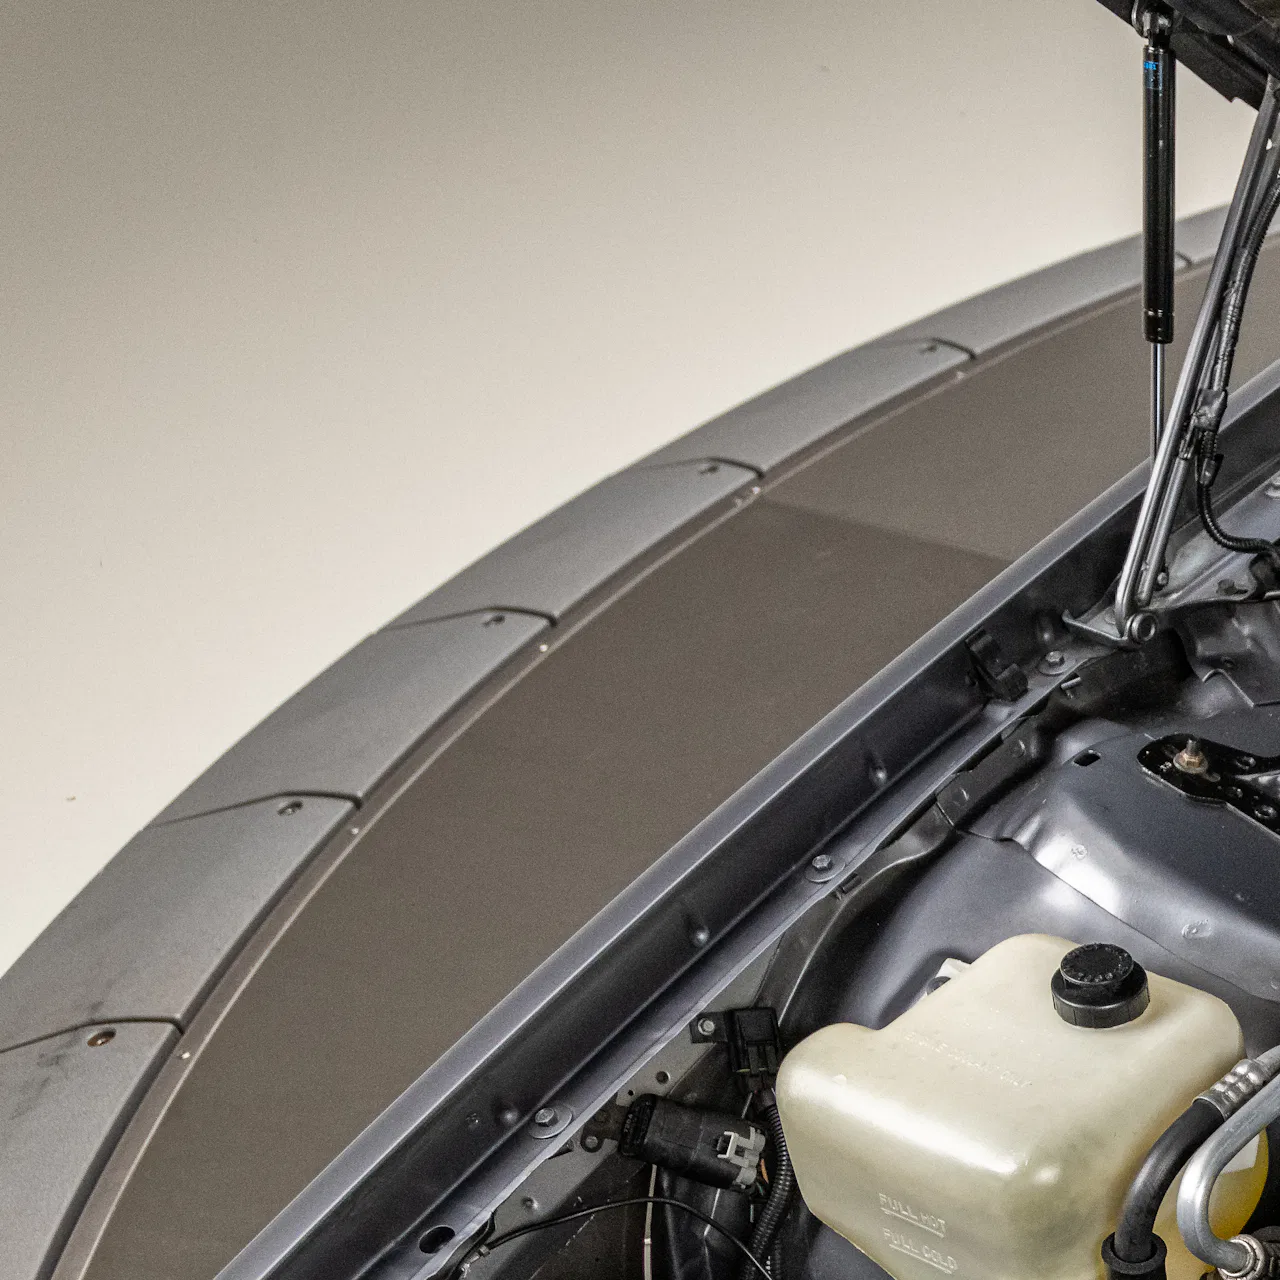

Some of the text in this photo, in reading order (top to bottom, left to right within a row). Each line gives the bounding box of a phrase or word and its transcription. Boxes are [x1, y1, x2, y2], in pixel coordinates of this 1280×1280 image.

[878, 1192, 946, 1233] FULL HOT
[882, 1227, 959, 1271] FULL COLD
